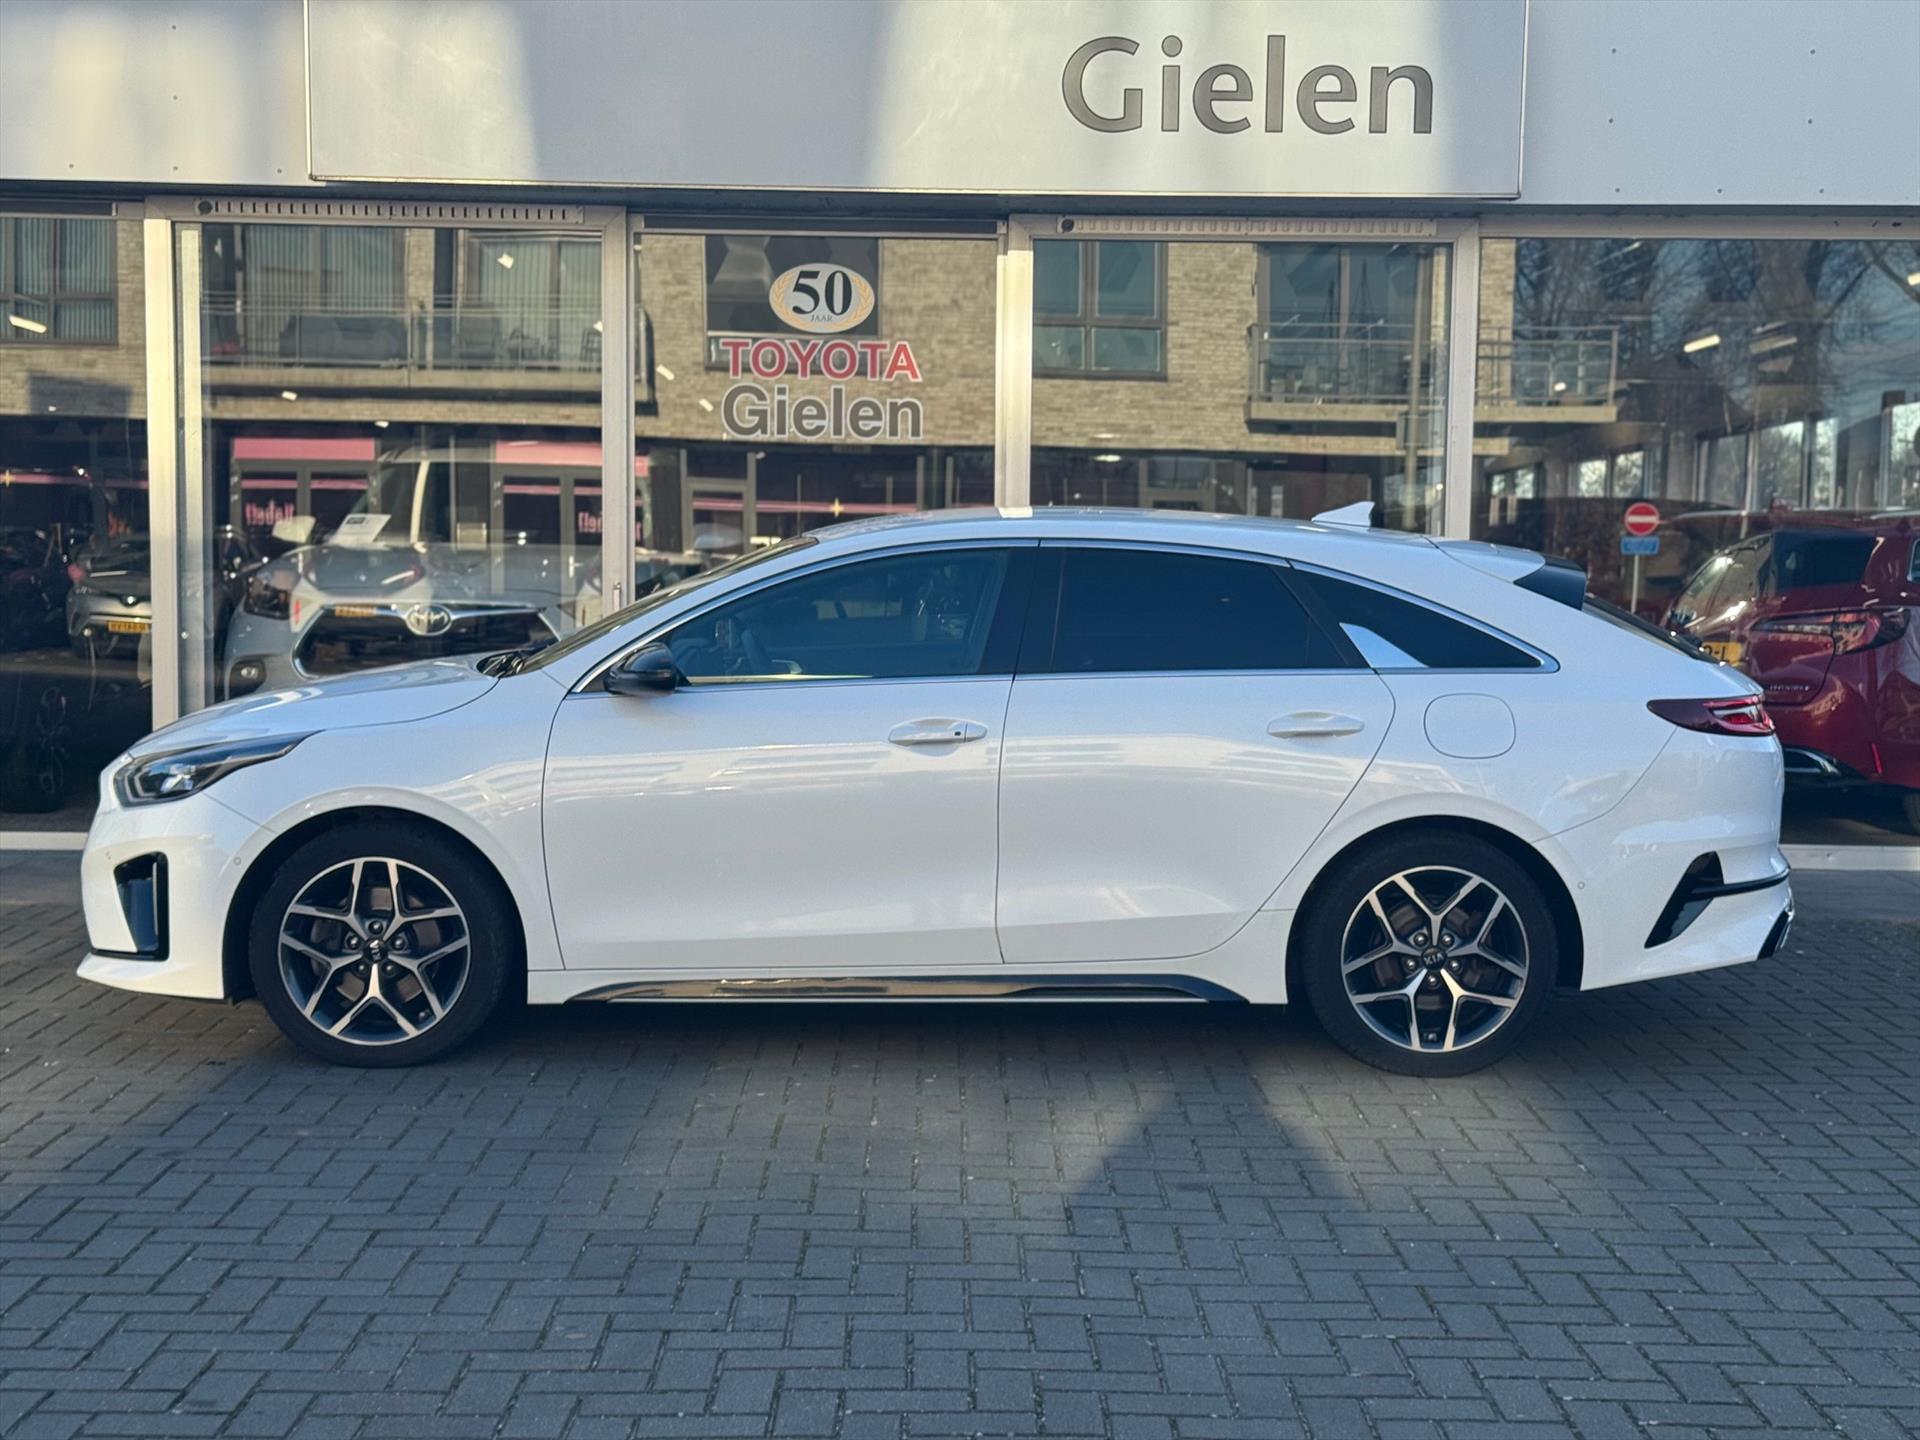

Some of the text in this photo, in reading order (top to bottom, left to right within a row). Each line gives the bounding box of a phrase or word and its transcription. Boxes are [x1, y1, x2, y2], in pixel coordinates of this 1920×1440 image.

[1062, 34, 1433, 134] Gielen
[792, 270, 852, 316] 50
[810, 314, 833, 322] JAAR
[720, 339, 922, 381] TOYOTA
[722, 383, 923, 439] Gielen
